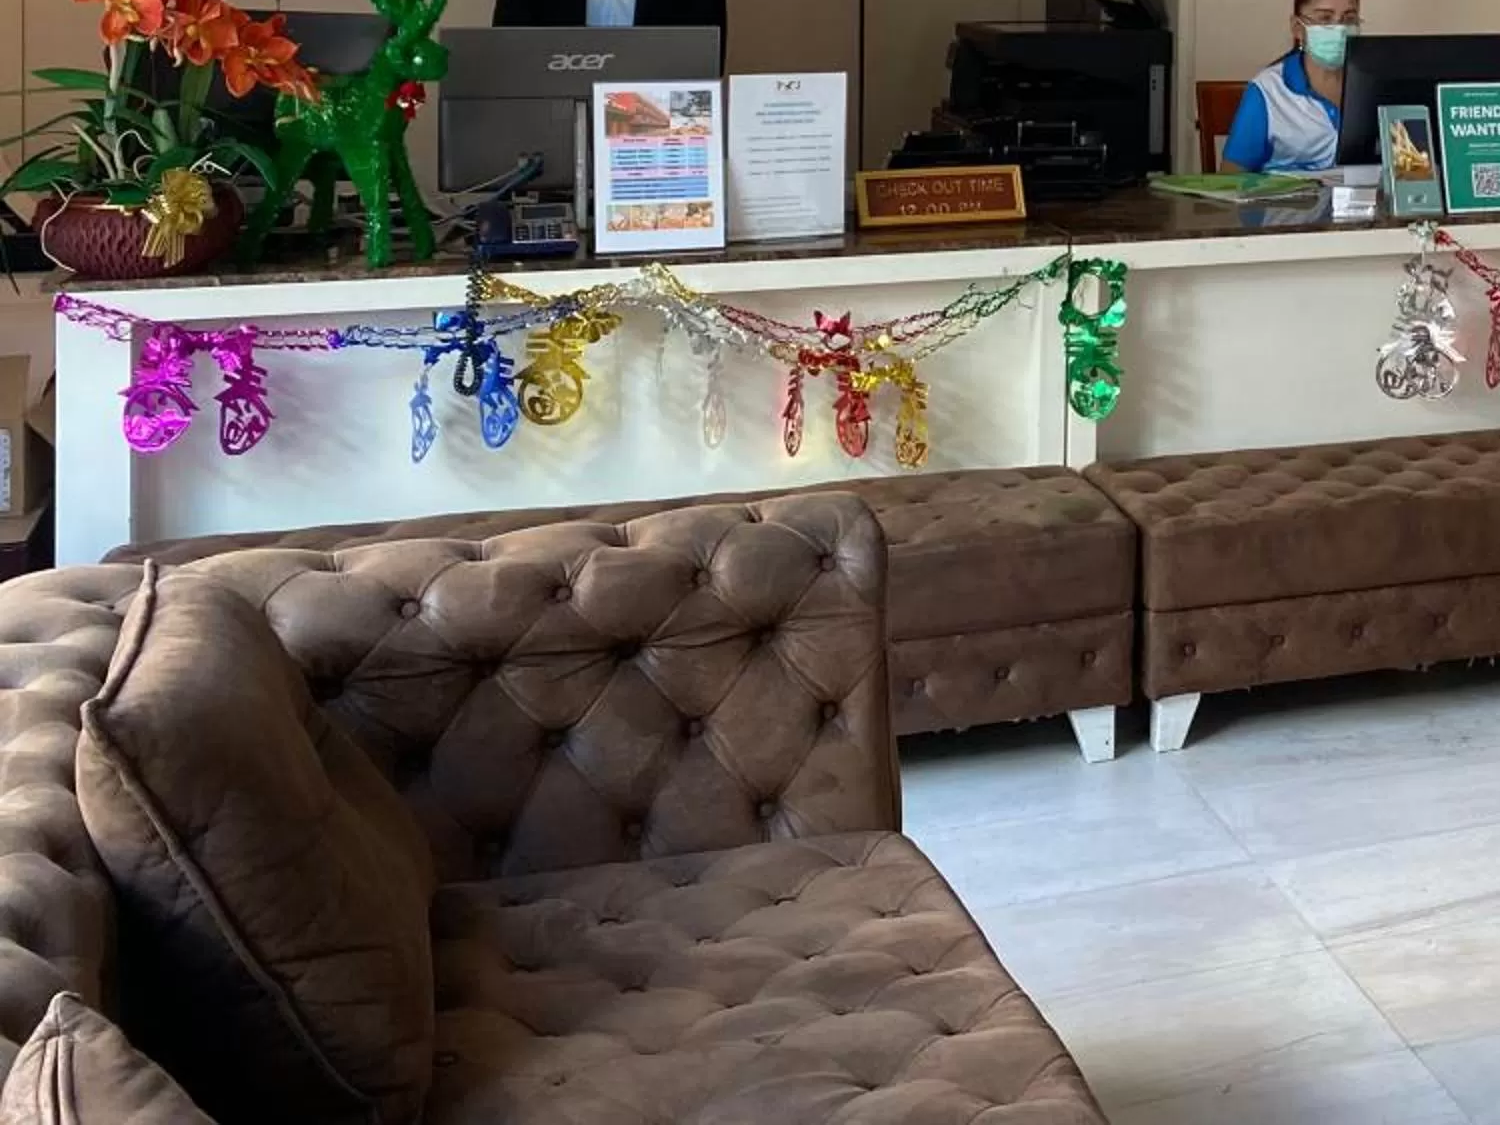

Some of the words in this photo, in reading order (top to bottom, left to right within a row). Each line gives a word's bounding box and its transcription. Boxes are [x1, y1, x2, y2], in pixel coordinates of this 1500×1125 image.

[547, 52, 615, 71] acer
[875, 181, 928, 198] CHECK
[931, 178, 962, 195] OUT
[968, 177, 1005, 193] TIME
